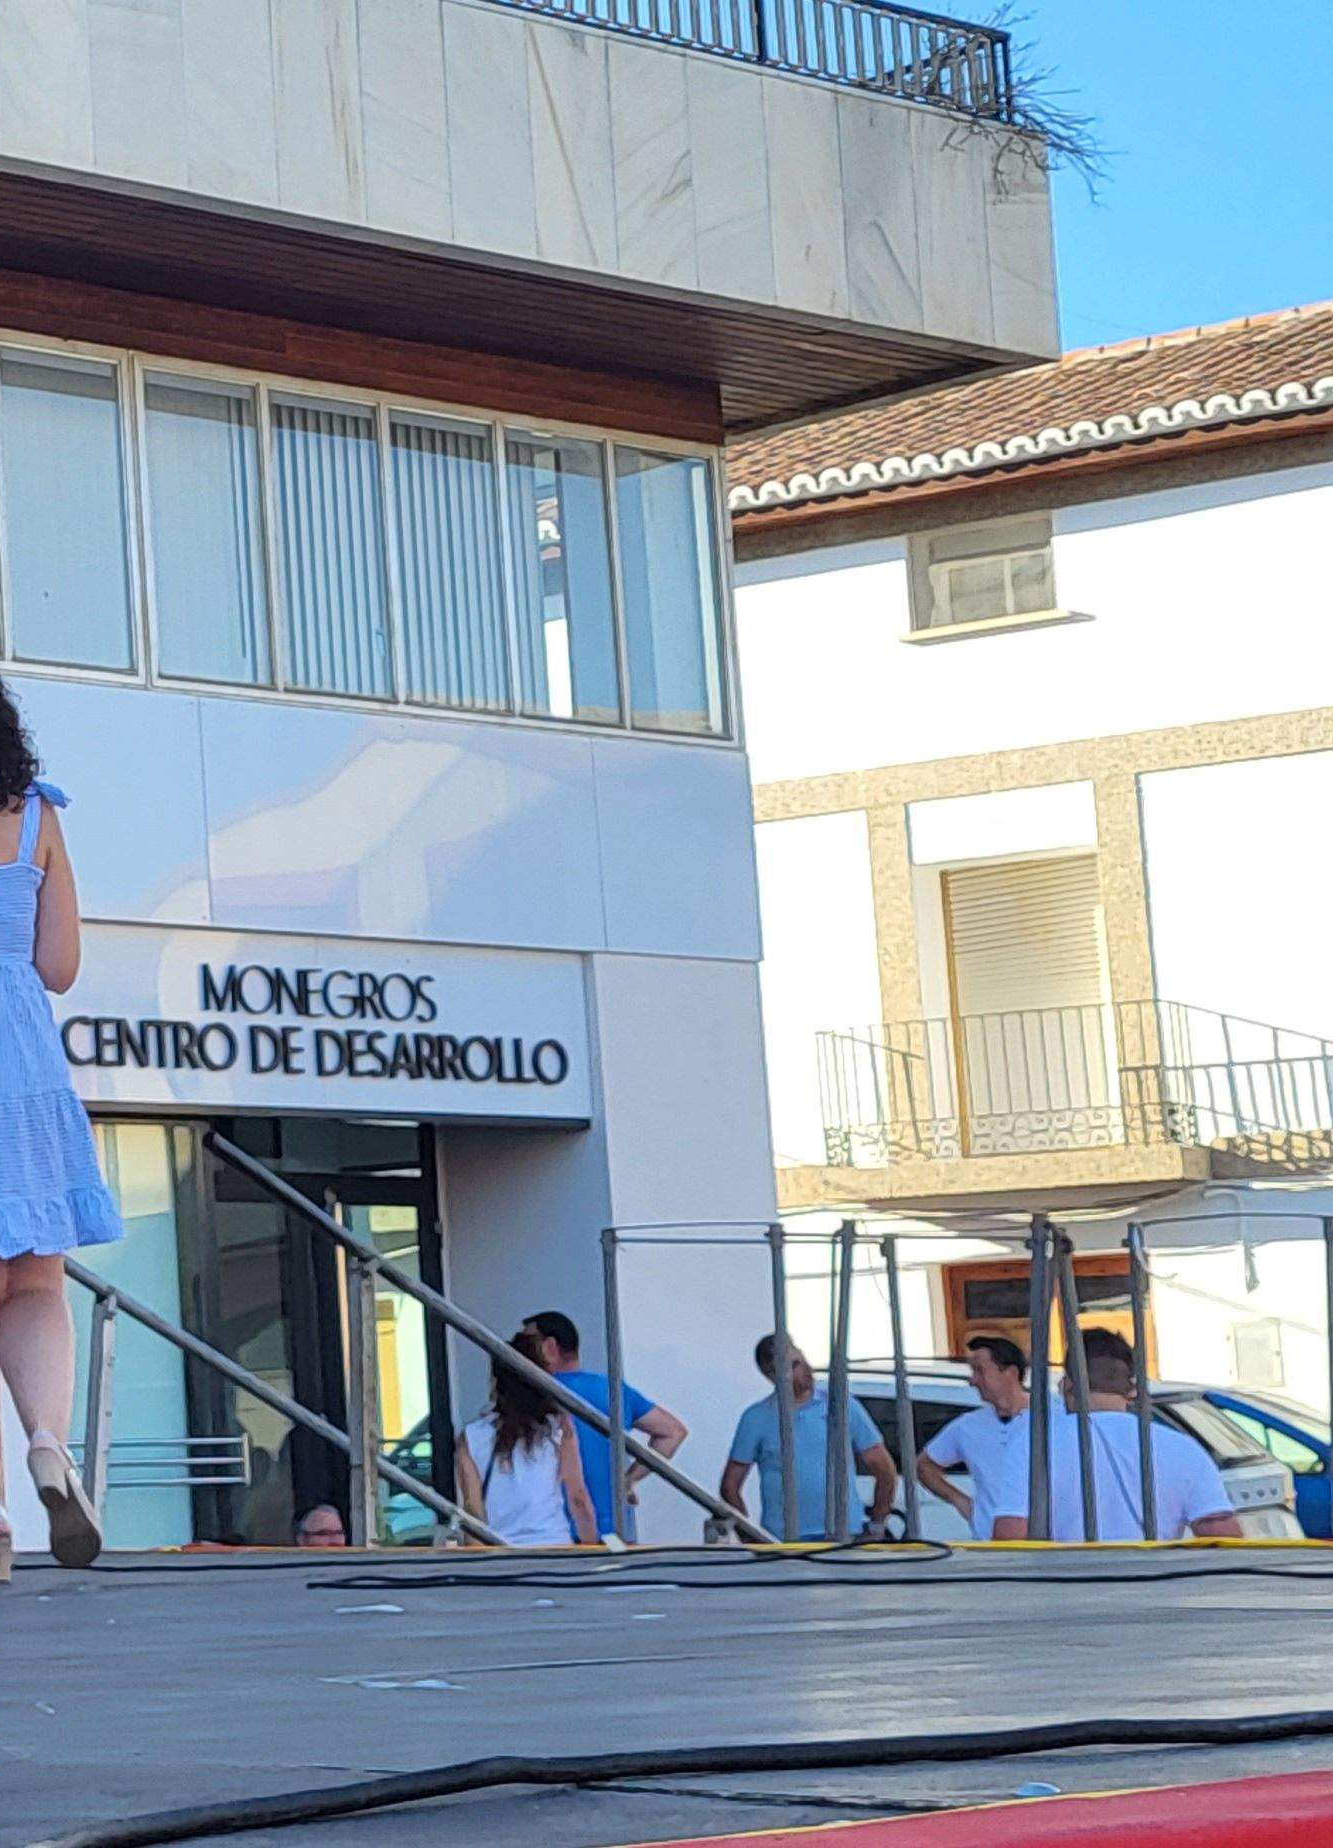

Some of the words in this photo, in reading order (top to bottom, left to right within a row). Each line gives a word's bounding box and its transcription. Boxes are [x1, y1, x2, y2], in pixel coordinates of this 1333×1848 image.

[199, 963, 436, 1023] MONEGROS
[62, 1016, 235, 1071] CENTRO
[248, 1025, 305, 1075] DE
[315, 1030, 570, 1086] DESARROLLO
